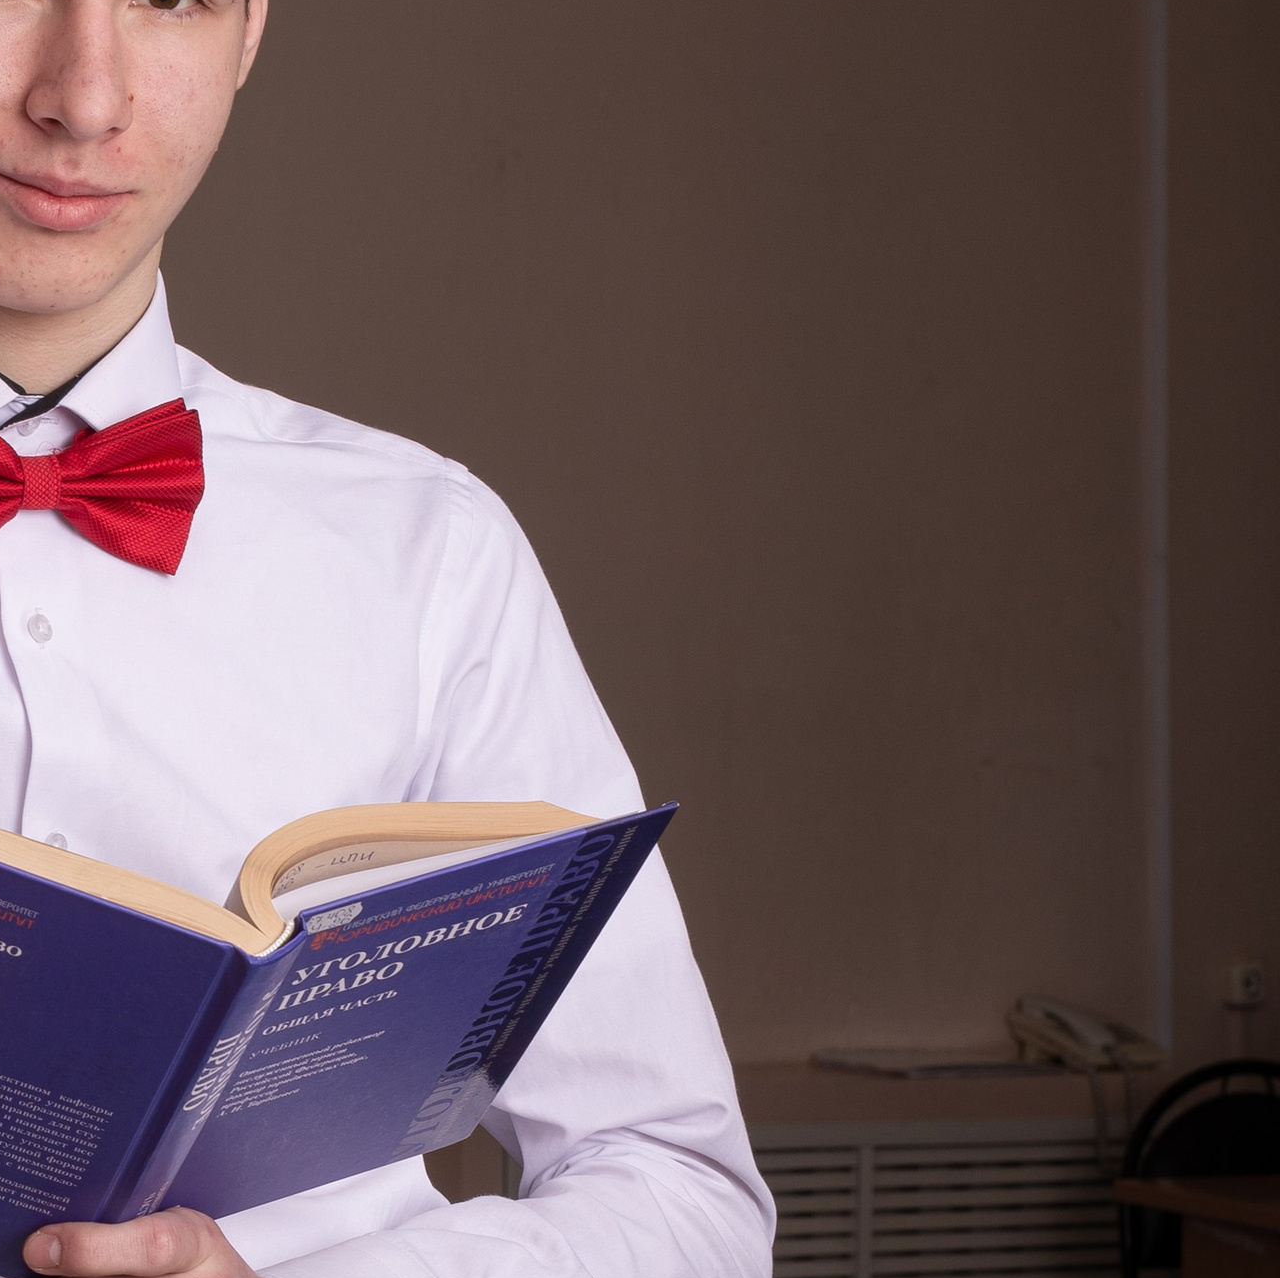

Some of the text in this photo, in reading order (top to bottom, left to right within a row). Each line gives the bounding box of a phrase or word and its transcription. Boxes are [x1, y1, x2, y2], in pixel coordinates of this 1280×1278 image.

[484, 861, 557, 890] УНИВЕРСИТЕТ
[333, 871, 551, 945] ЮРИДИЧЕСКИЙ ИНСТИТУТ
[510, 828, 622, 958] ПРАВО
[287, 901, 531, 987] УГОЛОВНОЕ
[273, 958, 408, 1012] ПРАВО
[260, 986, 401, 1037] ОБЩАЯ ЧАСТЬ
[248, 1030, 323, 1060] УЧЕБНИК
[182, 1032, 243, 1112] ПРАВО
[16, 1097, 106, 1135] образователь-
[44, 1099, 110, 1127] универси-
[57, 1092, 115, 1119] кафедры
[0, 1102, 44, 1124] право»
[47, 1118, 71, 1132] для
[73, 1128, 102, 1144] сту-
[13, 1116, 98, 1152] направлению
[8, 1124, 68, 1149] включает
[72, 1146, 94, 1158] все
[18, 1137, 90, 1167] уголовного
[16, 1163, 78, 1189] использо-
[43, 1153, 87, 1175] форме
[6, 1197, 54, 1219] правом.
[18, 1192, 66, 1212] полезен
